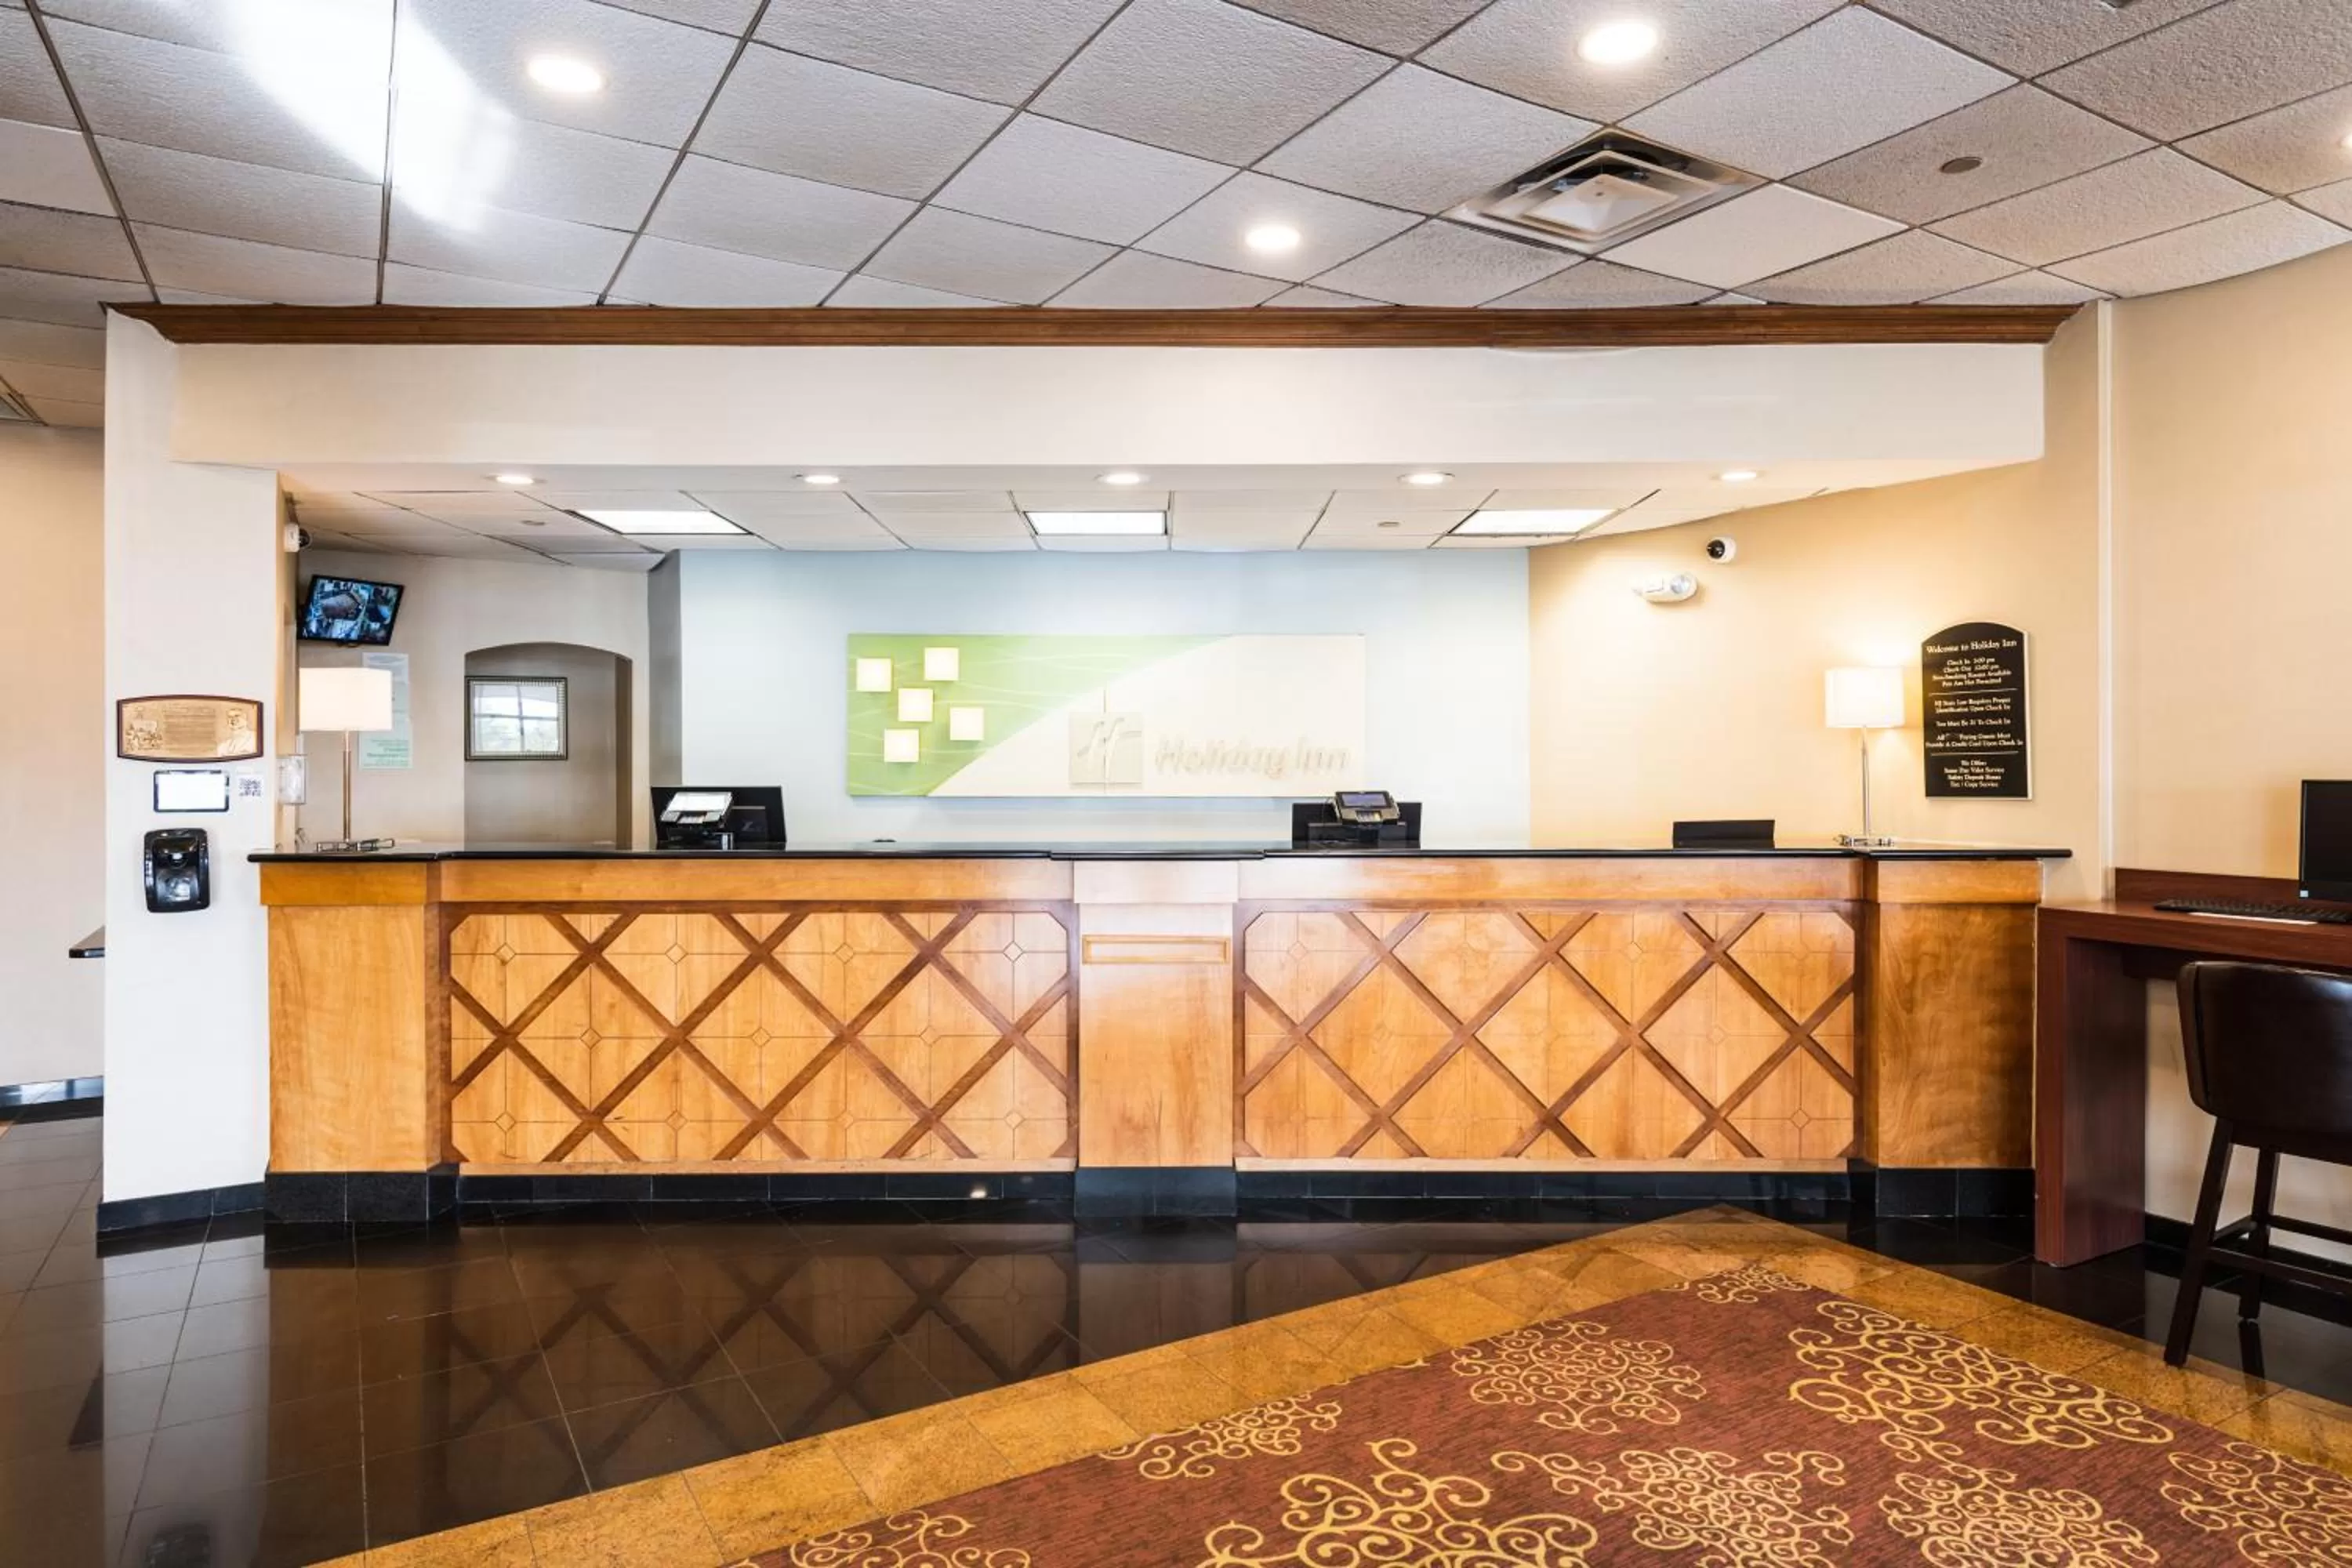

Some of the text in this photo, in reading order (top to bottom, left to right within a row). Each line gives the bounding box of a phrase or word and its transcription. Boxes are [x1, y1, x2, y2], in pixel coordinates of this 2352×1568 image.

[1926, 645, 1959, 654] Welcome
[1970, 641, 2000, 651] Holiday
[1154, 733, 1353, 779] Holiday Inn
